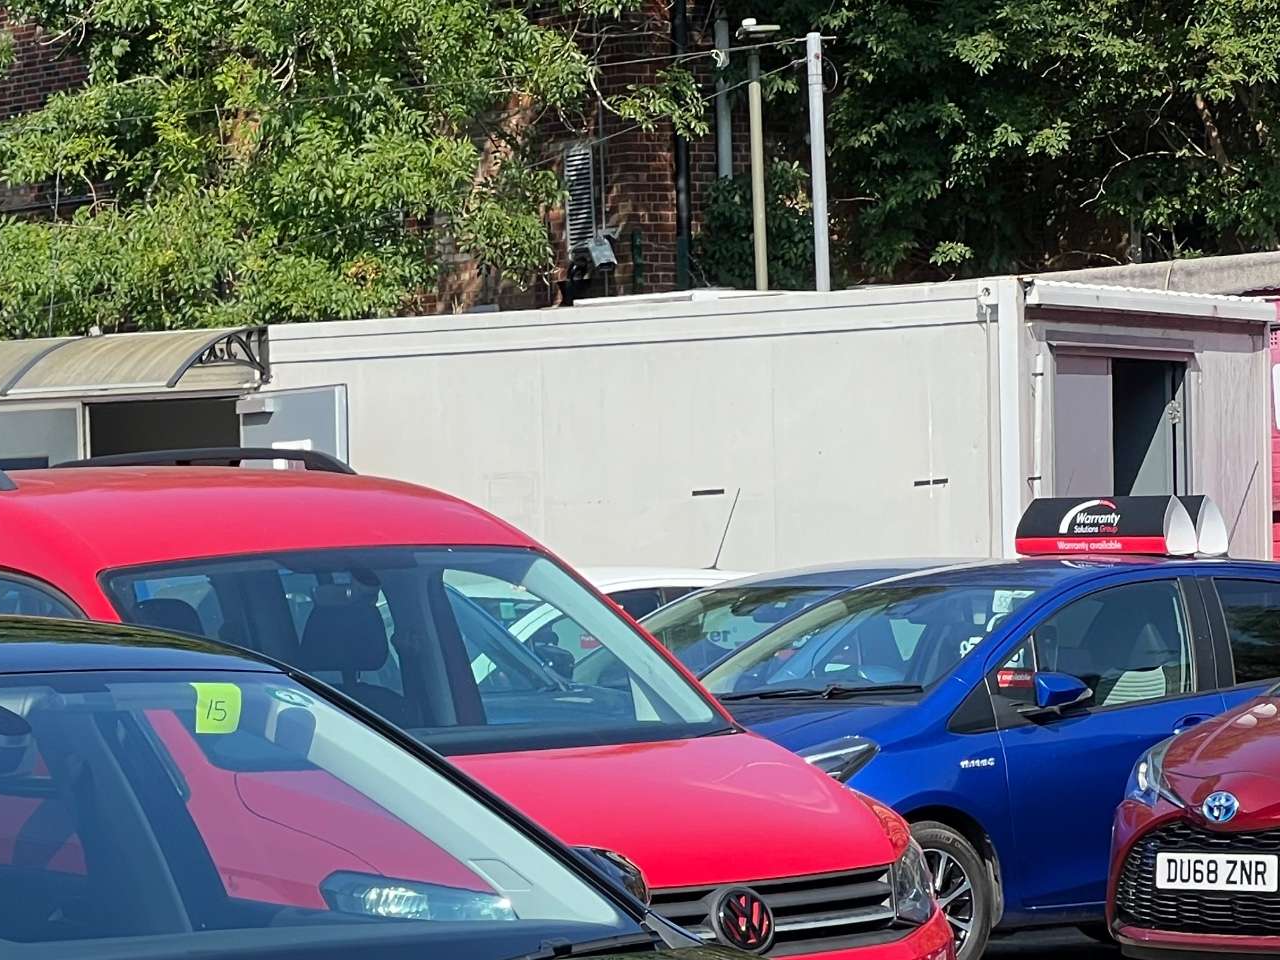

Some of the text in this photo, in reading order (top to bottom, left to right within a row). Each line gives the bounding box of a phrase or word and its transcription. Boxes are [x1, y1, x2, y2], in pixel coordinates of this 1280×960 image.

[1076, 512, 1121, 527] Warranty
[1073, 525, 1099, 534] Solutions
[1056, 540, 1122, 551] Warranty available
[206, 699, 228, 722] 15
[1166, 858, 1267, 886] DU68 ZNR
